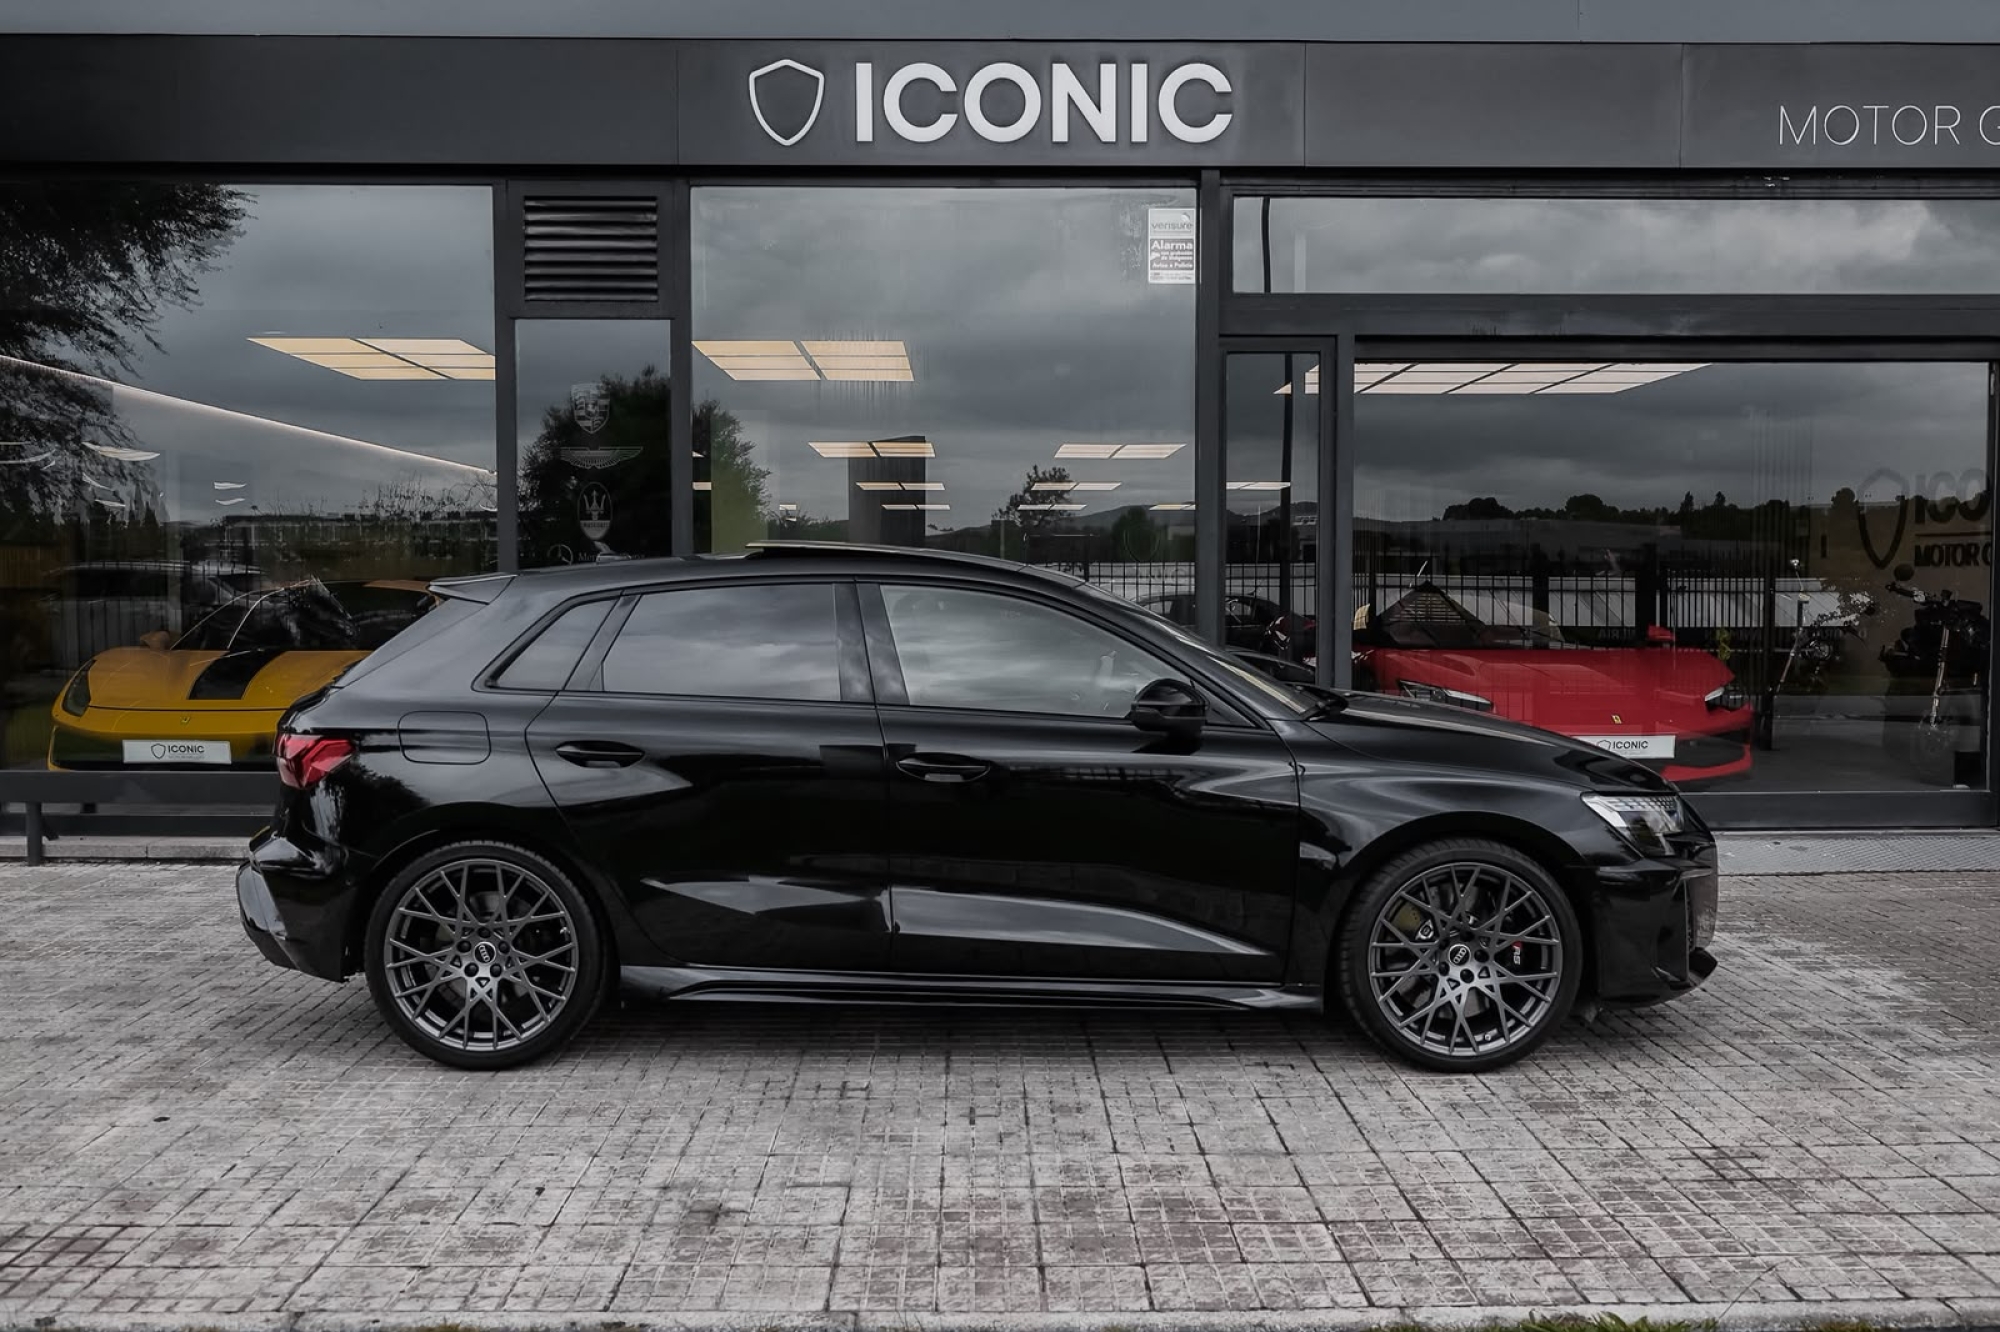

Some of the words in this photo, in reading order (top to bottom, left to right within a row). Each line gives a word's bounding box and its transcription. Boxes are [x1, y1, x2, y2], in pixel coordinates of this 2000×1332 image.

[856, 62, 1233, 143] ICONIC
[1779, 104, 1961, 146] MOTOR
[1151, 221, 1194, 230] verisure
[1151, 240, 1193, 250] Alarma
[1914, 543, 1980, 567] MOTOR
[168, 745, 205, 753] ICONIC
[1613, 740, 1649, 749] ICONIC
